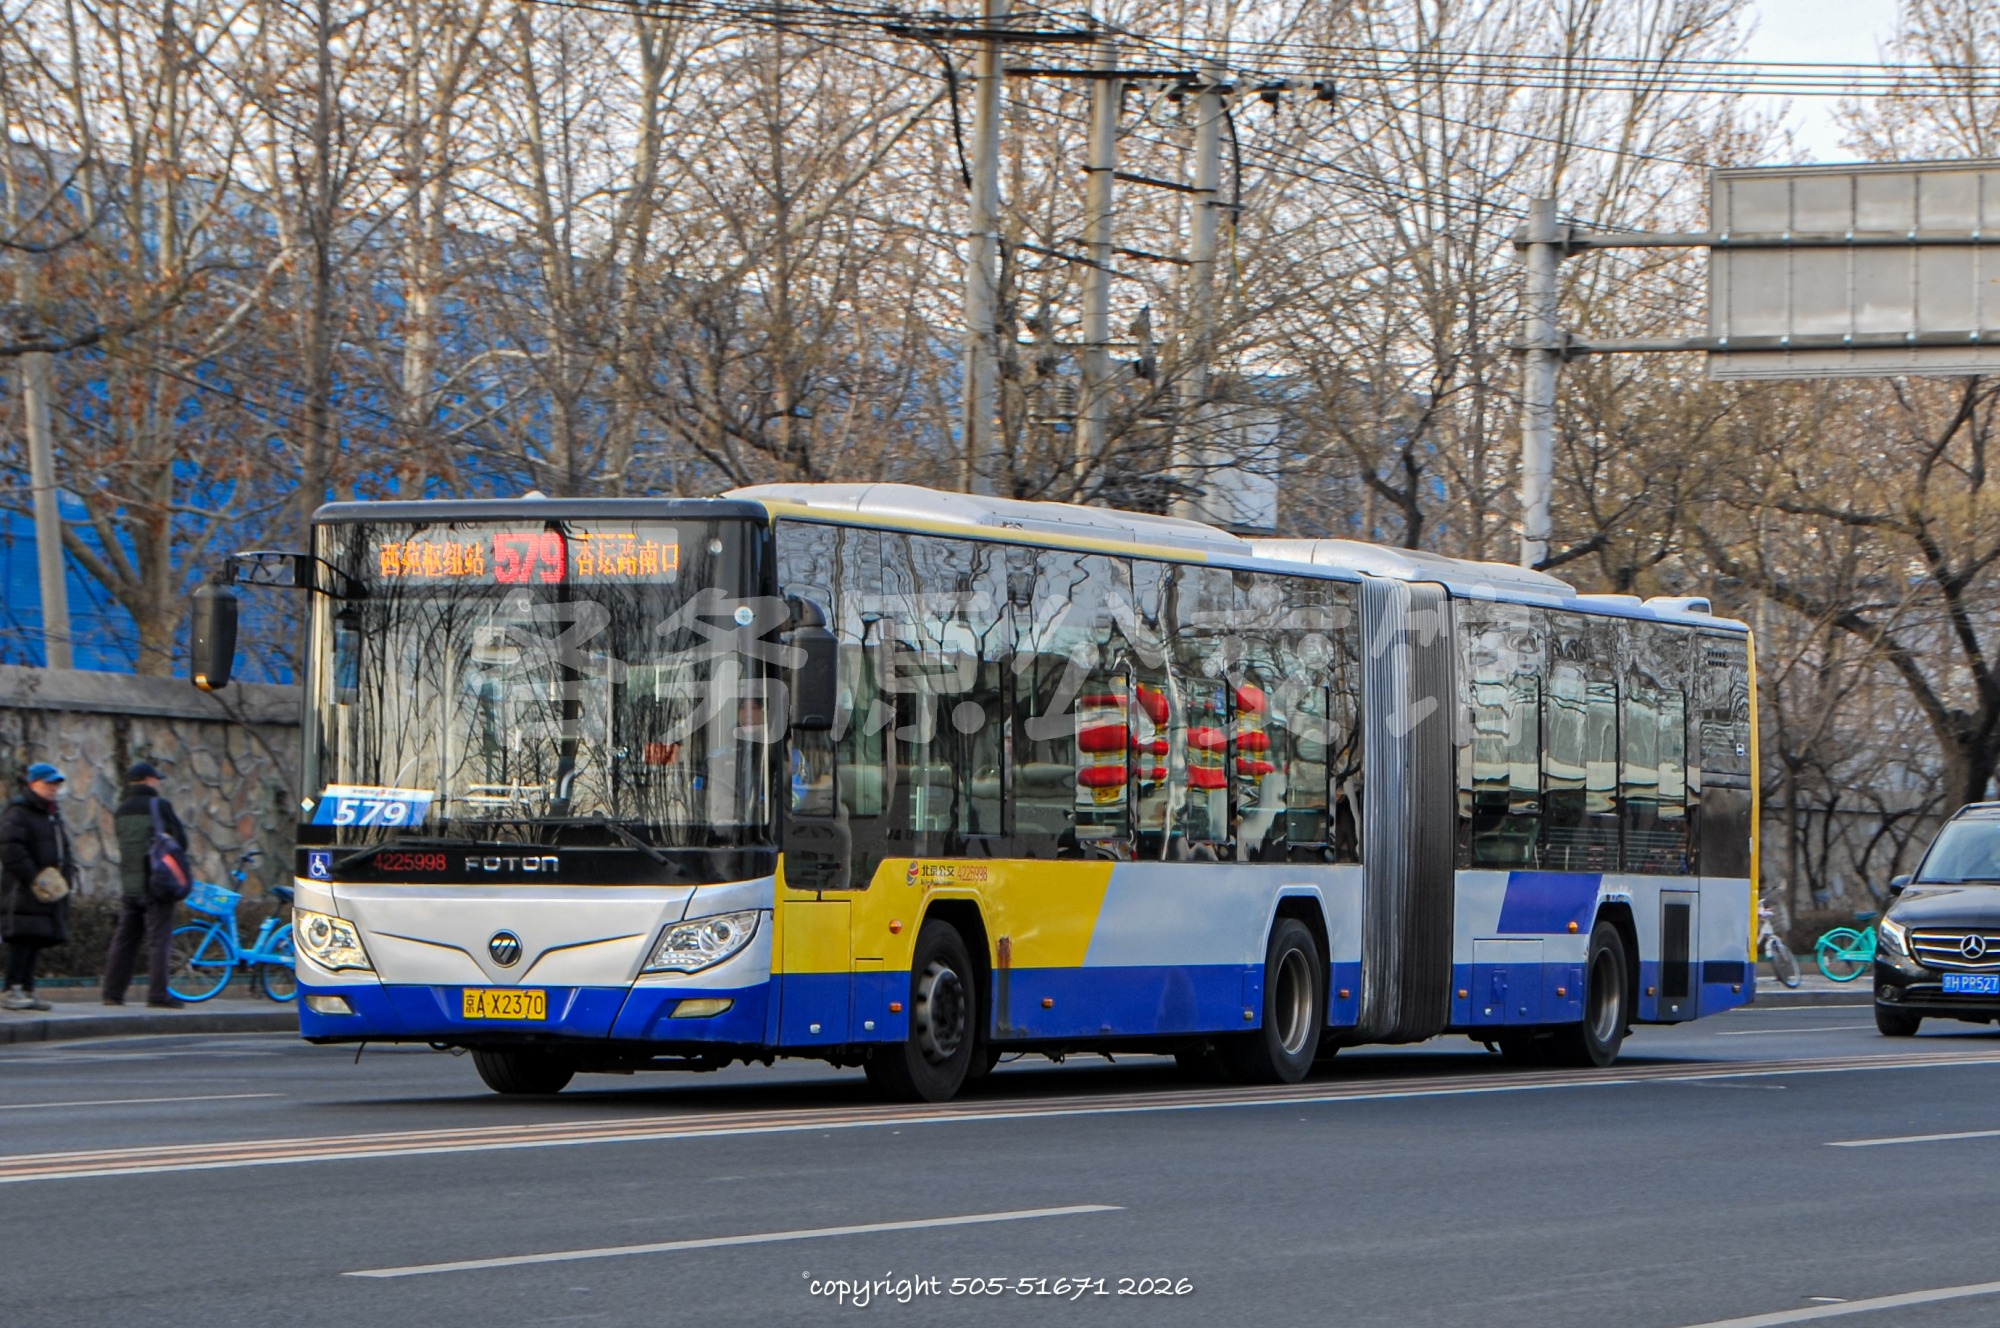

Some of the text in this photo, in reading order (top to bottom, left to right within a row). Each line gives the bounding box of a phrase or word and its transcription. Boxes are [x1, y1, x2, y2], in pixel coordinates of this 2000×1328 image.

[380, 532, 680, 583] 西苑枢纽站 579 杏坛路南口
[332, 799, 407, 826] 579
[374, 853, 447, 871] 4225998
[464, 856, 559, 872] FOTON
[921, 864, 955, 877] 北京公交
[957, 865, 988, 882] 4225998
